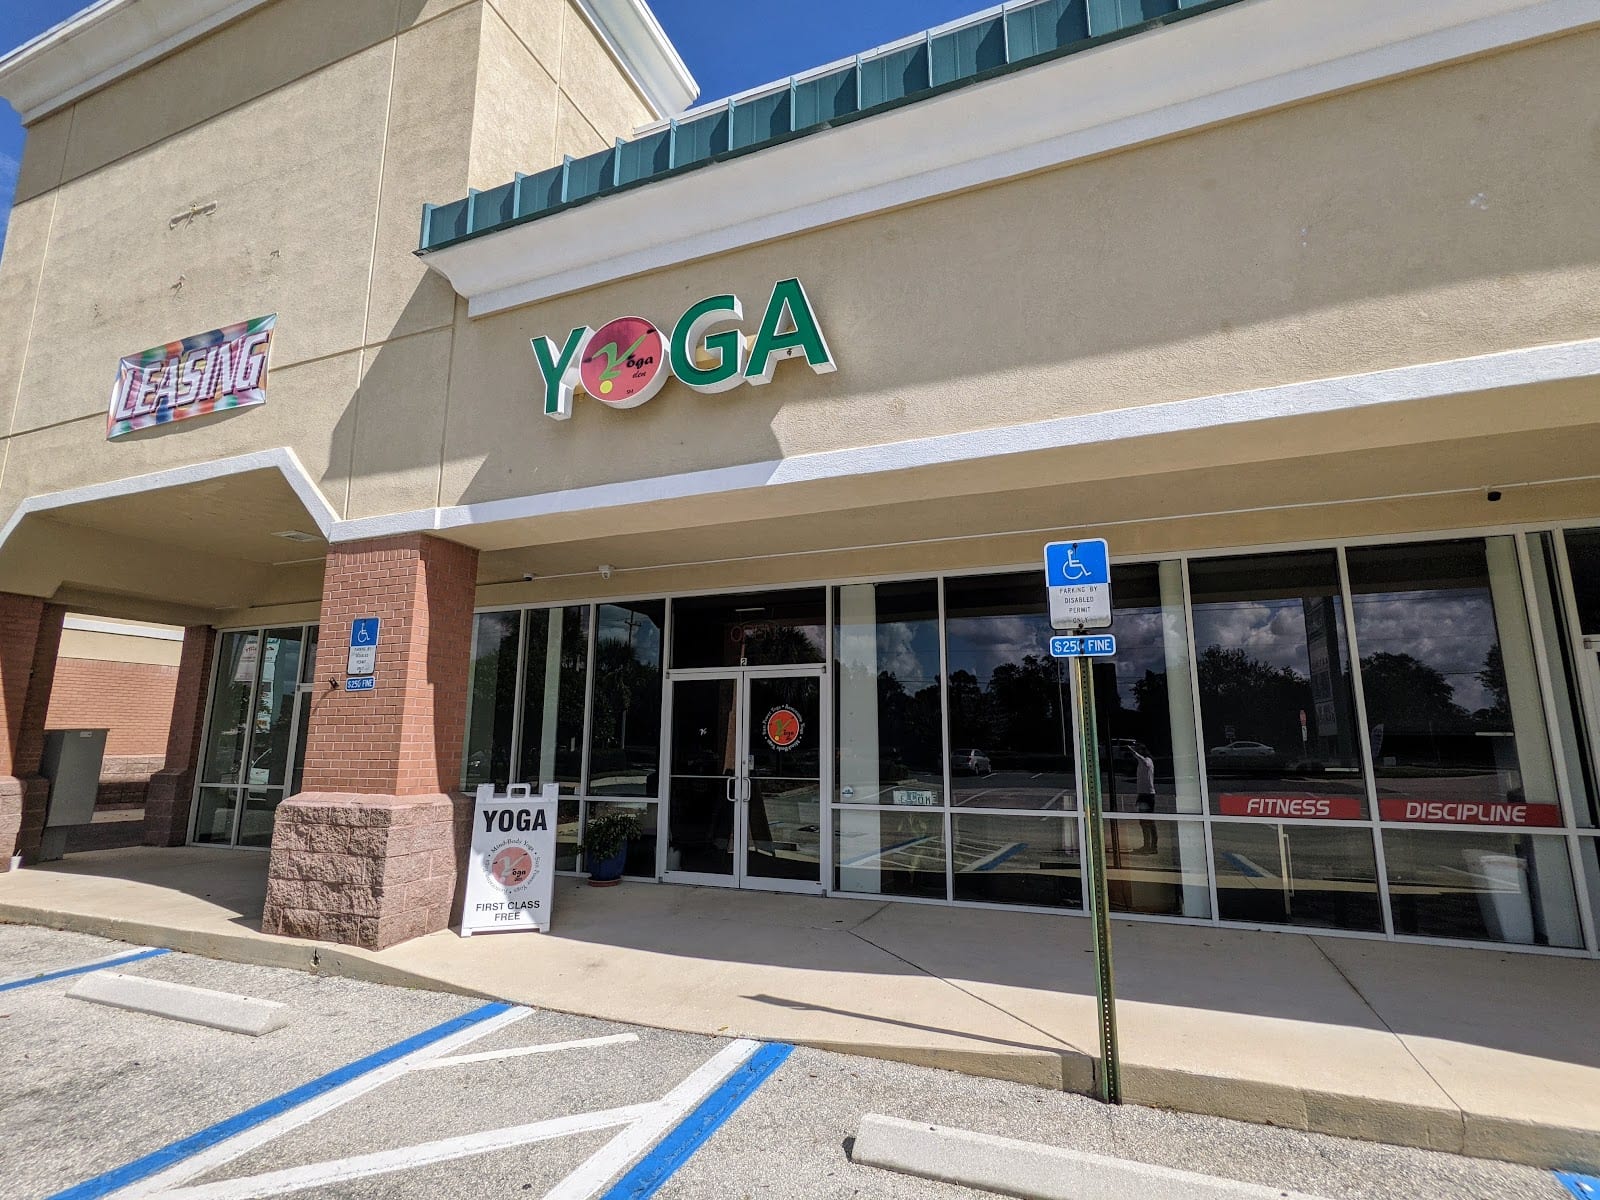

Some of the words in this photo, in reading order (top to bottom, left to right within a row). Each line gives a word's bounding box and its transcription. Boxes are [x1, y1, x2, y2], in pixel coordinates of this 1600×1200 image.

[530, 277, 836, 420] YOGA
[115, 330, 270, 421] LEASING
[1064, 596, 1094, 604] DISABLED
[1068, 606, 1091, 614] PERMIT
[1088, 639, 1112, 652] FINE
[362, 678, 374, 687] FINE
[1247, 798, 1331, 816] FITNESS
[1405, 802, 1527, 823] DISCIPLINE
[483, 808, 548, 833] YOGA
[475, 902, 507, 912] FIRST
[507, 900, 540, 911] CLASS
[494, 911, 521, 921] FREE
